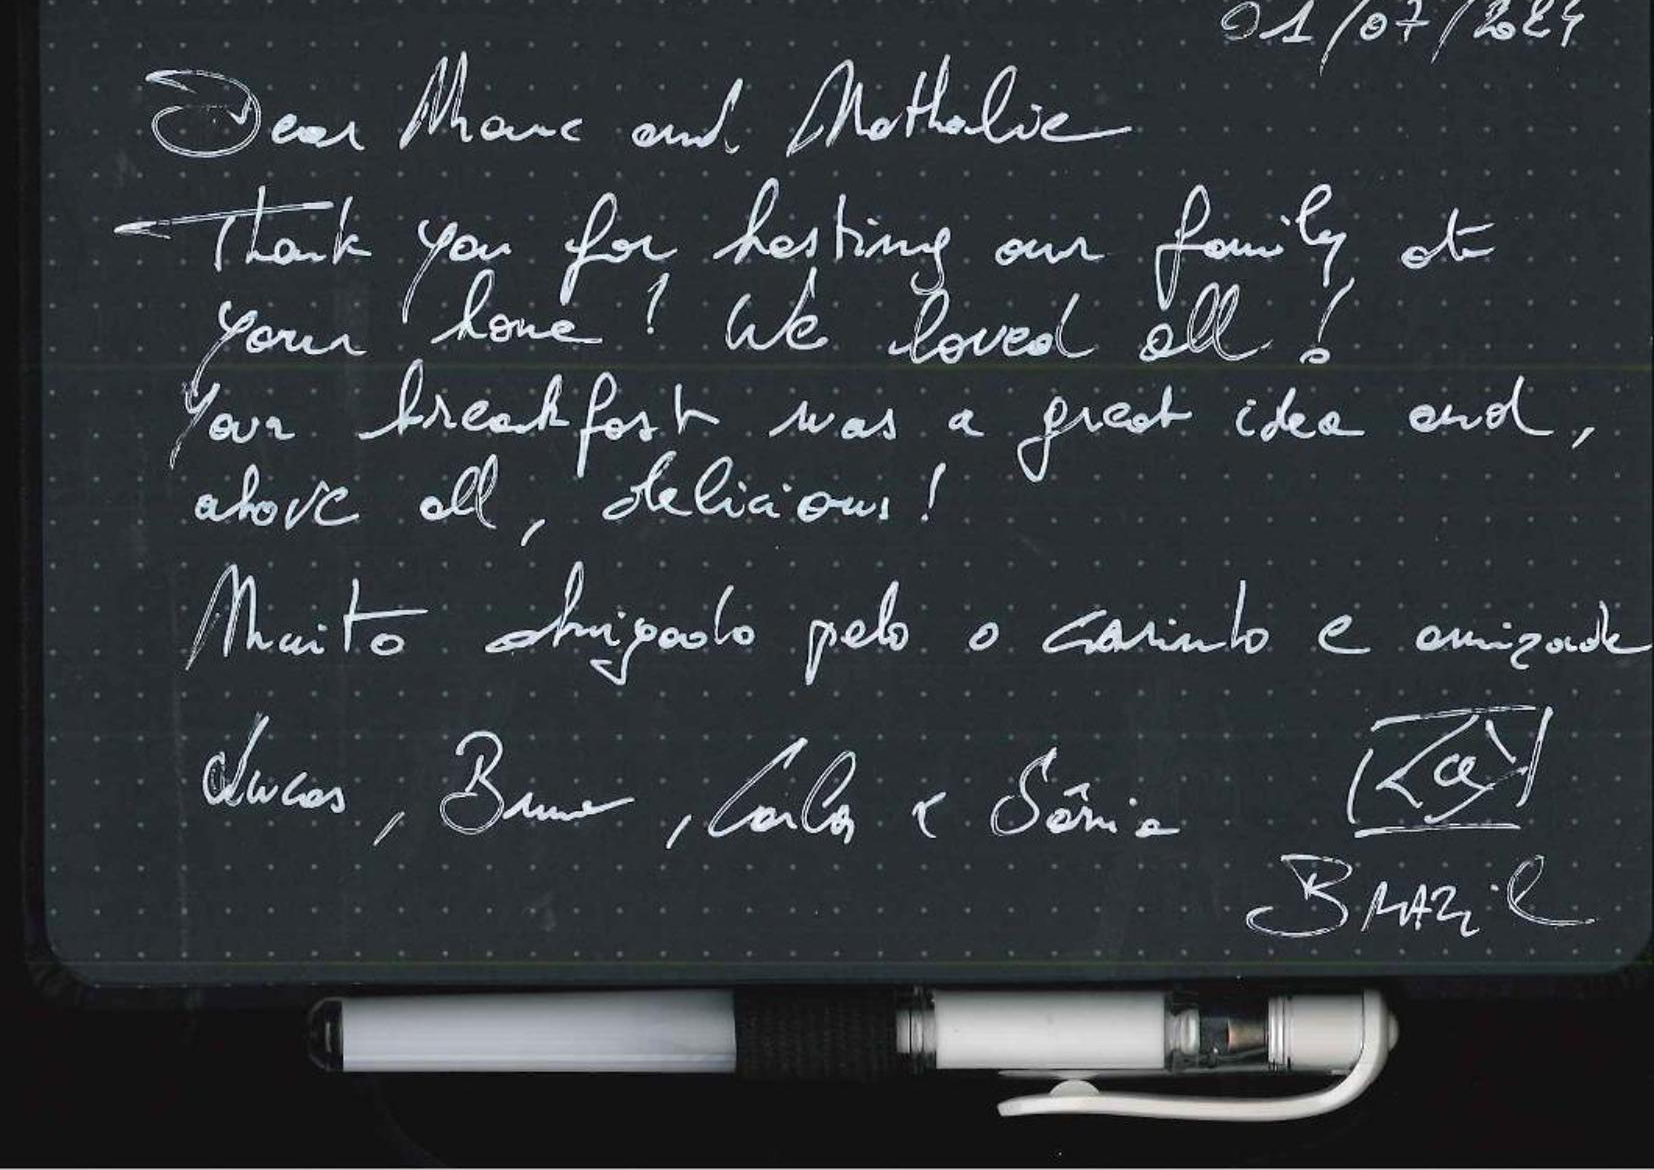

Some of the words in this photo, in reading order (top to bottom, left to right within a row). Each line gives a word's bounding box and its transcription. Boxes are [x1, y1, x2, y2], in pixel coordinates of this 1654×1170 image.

[145, 69, 364, 159] Dear
[114, 185, 373, 273] Thank
[401, 219, 512, 324] you
[559, 191, 678, 307] for
[712, 177, 934, 296] hosting
[995, 236, 1105, 266] our
[1154, 184, 1347, 312] family
[1400, 207, 1495, 270] at
[182, 300, 368, 399] your
[725, 266, 830, 351] We
[888, 290, 1096, 365] loved
[168, 382, 296, 470] Your
[357, 358, 720, 479] breakfast
[769, 400, 897, 441] was
[948, 408, 985, 437] a
[1016, 384, 1193, 483] great
[1235, 387, 1366, 442] idea
[194, 463, 360, 531] above
[185, 563, 429, 671] Muito
[484, 560, 756, 686] obrigado
[804, 580, 909, 686] pelo
[966, 621, 1000, 652] o
[1317, 614, 1371, 655] e
[1415, 600, 1653, 670] amizade
